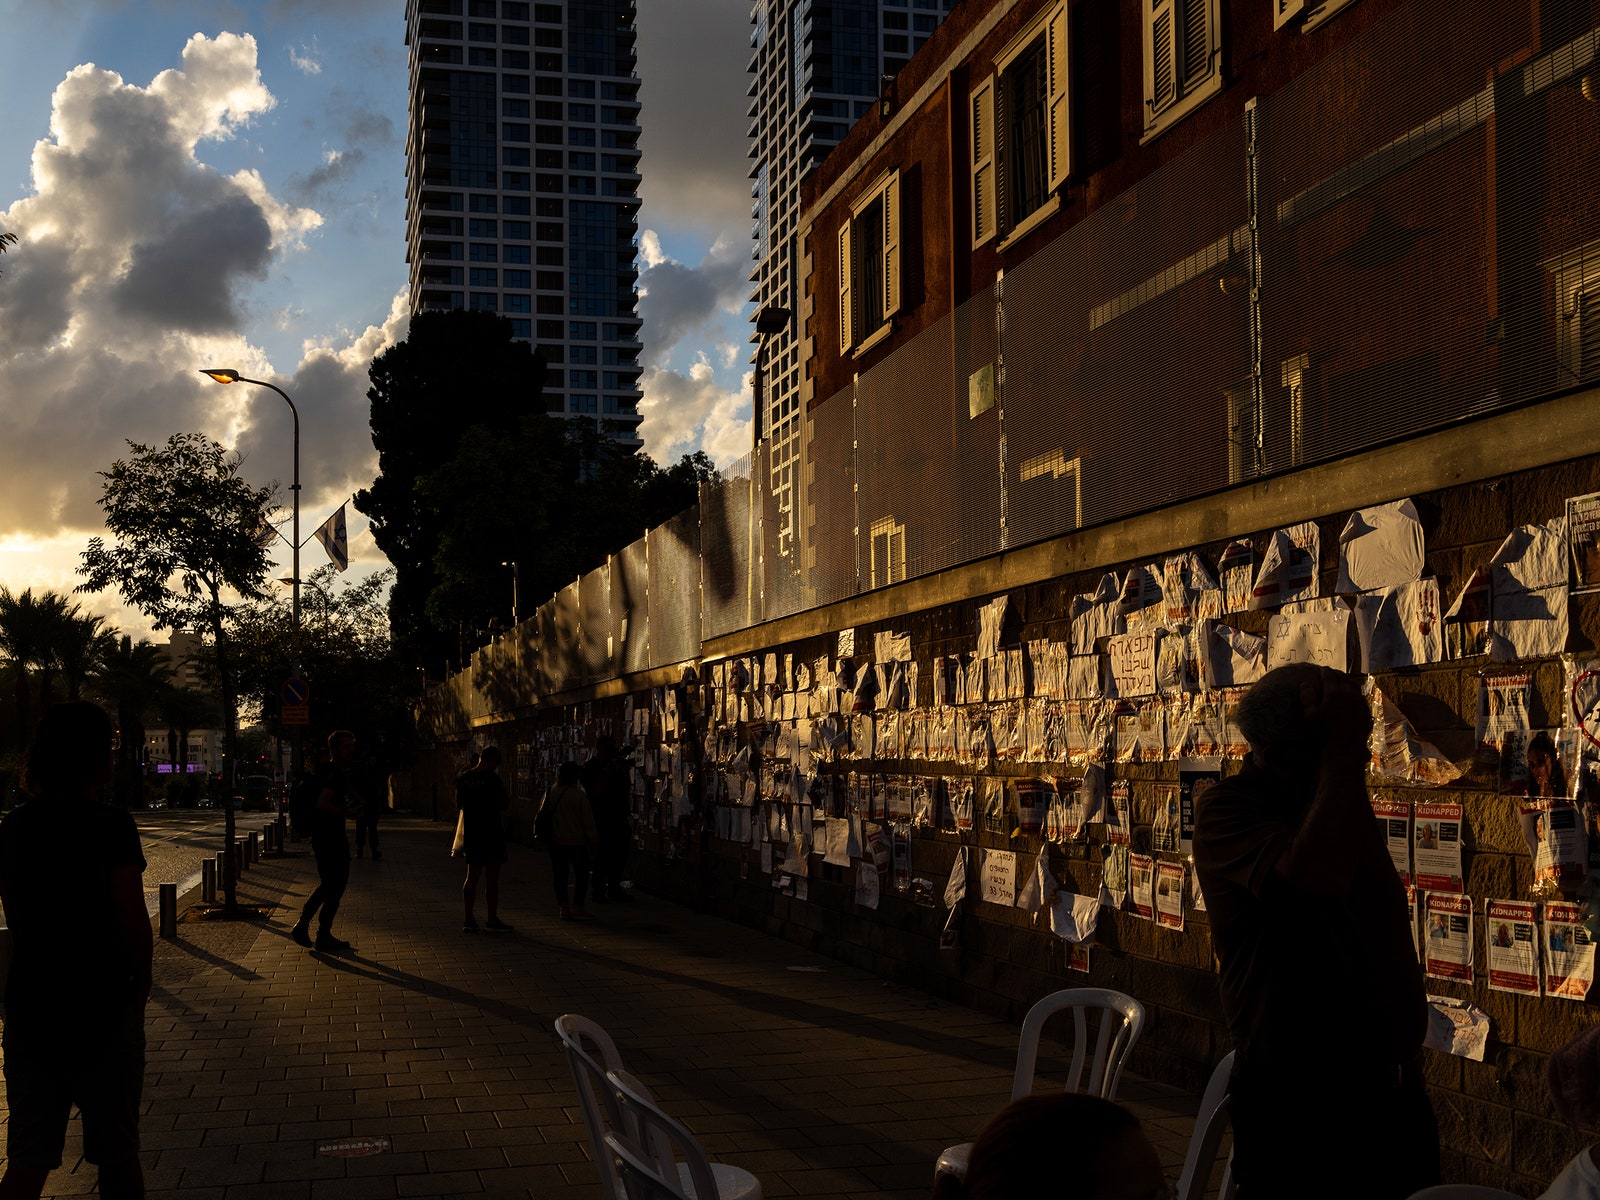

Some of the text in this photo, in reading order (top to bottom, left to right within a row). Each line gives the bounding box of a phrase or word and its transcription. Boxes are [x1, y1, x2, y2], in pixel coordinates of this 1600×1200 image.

[1417, 806, 1460, 816] KIDNAPPED
[1429, 900, 1468, 911] KIDNAPPED
[1490, 907, 1532, 918] KIDNAPPED
